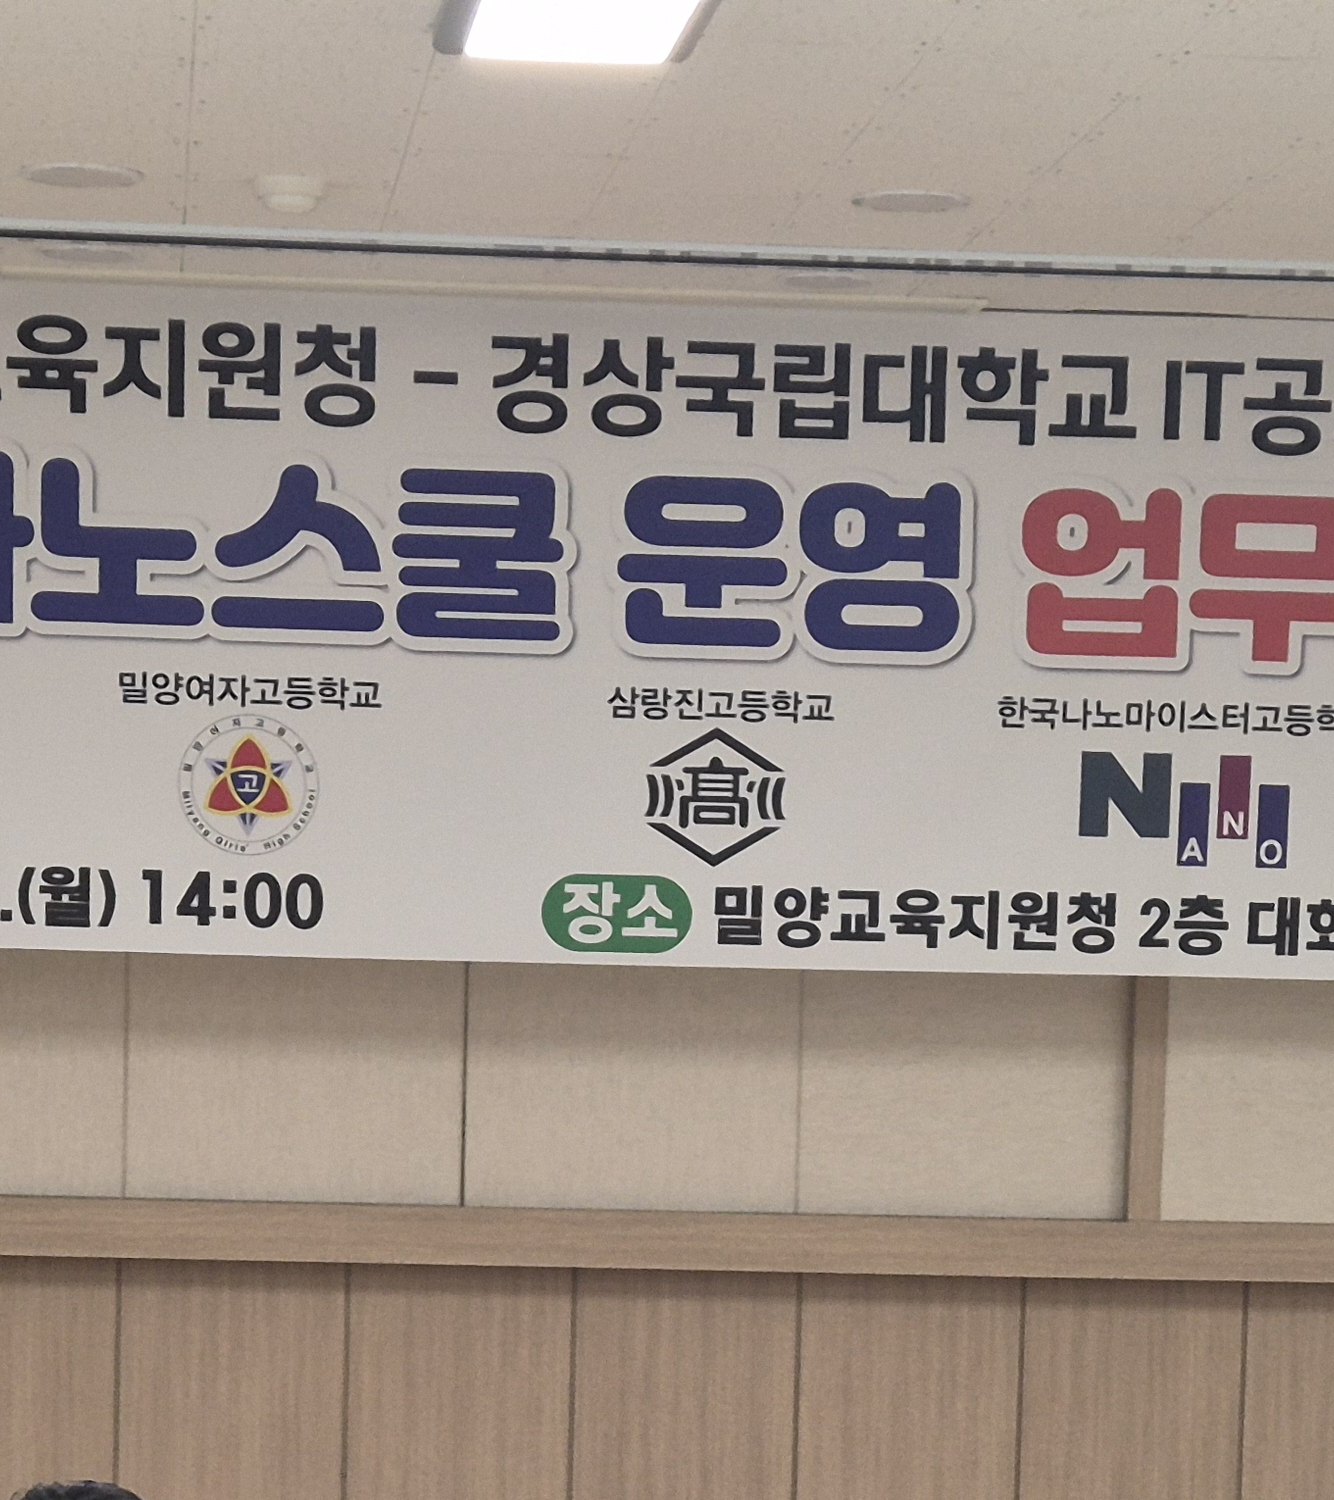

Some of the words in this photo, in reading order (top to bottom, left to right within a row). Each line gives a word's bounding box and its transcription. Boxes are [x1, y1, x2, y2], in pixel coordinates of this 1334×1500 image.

[492, 333, 1137, 446] 경상국립대학교
[618, 475, 959, 652] 운영
[118, 671, 382, 711] 밀양여자고등학교
[607, 686, 835, 724] 삼랑진고등학교
[141, 869, 324, 930] 14:00
[563, 881, 678, 944] 장소
[714, 885, 1117, 955] 밀양교육지원청
[1138, 894, 1229, 956] 2층
